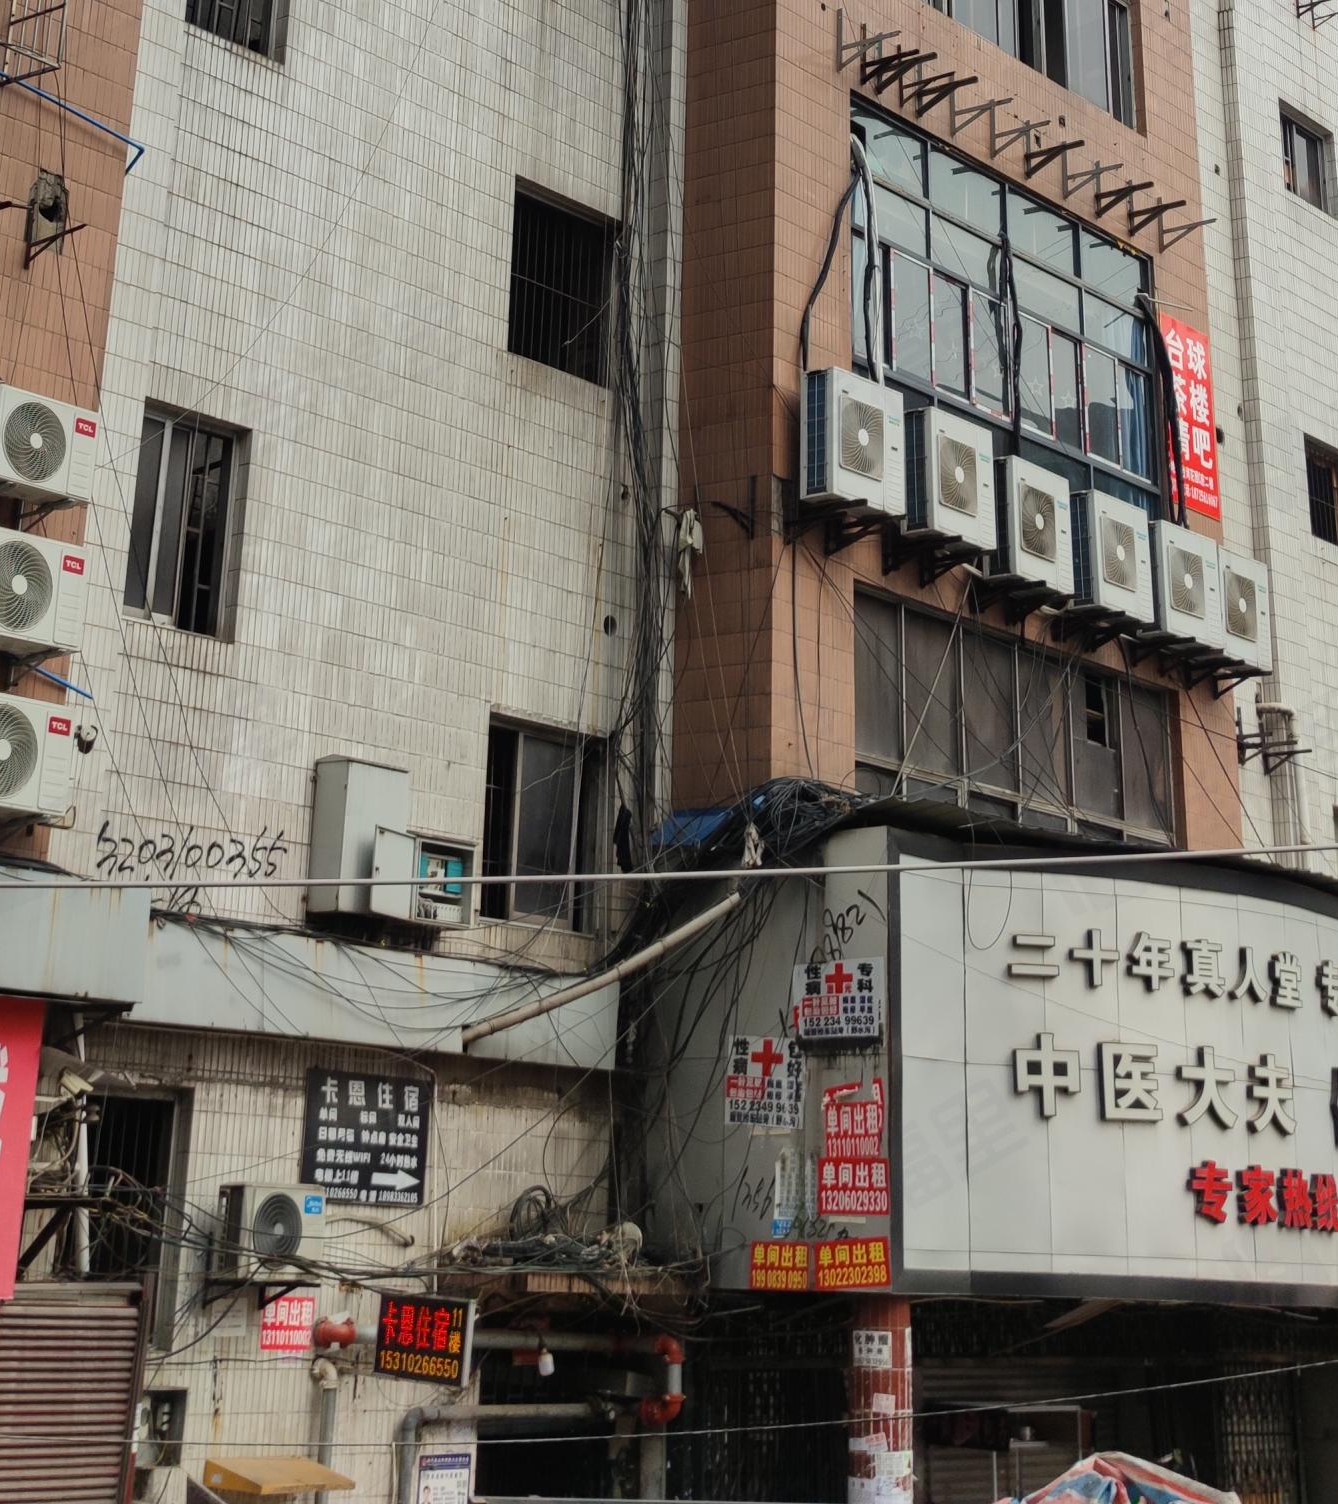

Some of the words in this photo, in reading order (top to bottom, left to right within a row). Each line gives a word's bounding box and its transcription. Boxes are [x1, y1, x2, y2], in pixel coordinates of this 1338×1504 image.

[78, 421, 94, 434] TCL
[65, 559, 82, 571] TCL
[50, 720, 69, 733] TCL
[1007, 928, 1303, 1010] 二十年真人堂
[321, 1076, 420, 1112] 卡恩住宿
[1012, 1032, 1297, 1136] 中医大夫
[827, 1104, 879, 1136] 单间出租
[822, 1162, 887, 1188] 单间出租
[821, 1190, 888, 1211] 13206029330
[753, 1244, 808, 1267] 单间出租
[819, 1242, 886, 1267] 单间出租
[818, 1265, 887, 1288] 13022302398
[263, 1299, 314, 1327] 单间出租
[380, 1349, 460, 1379] 15310266550
